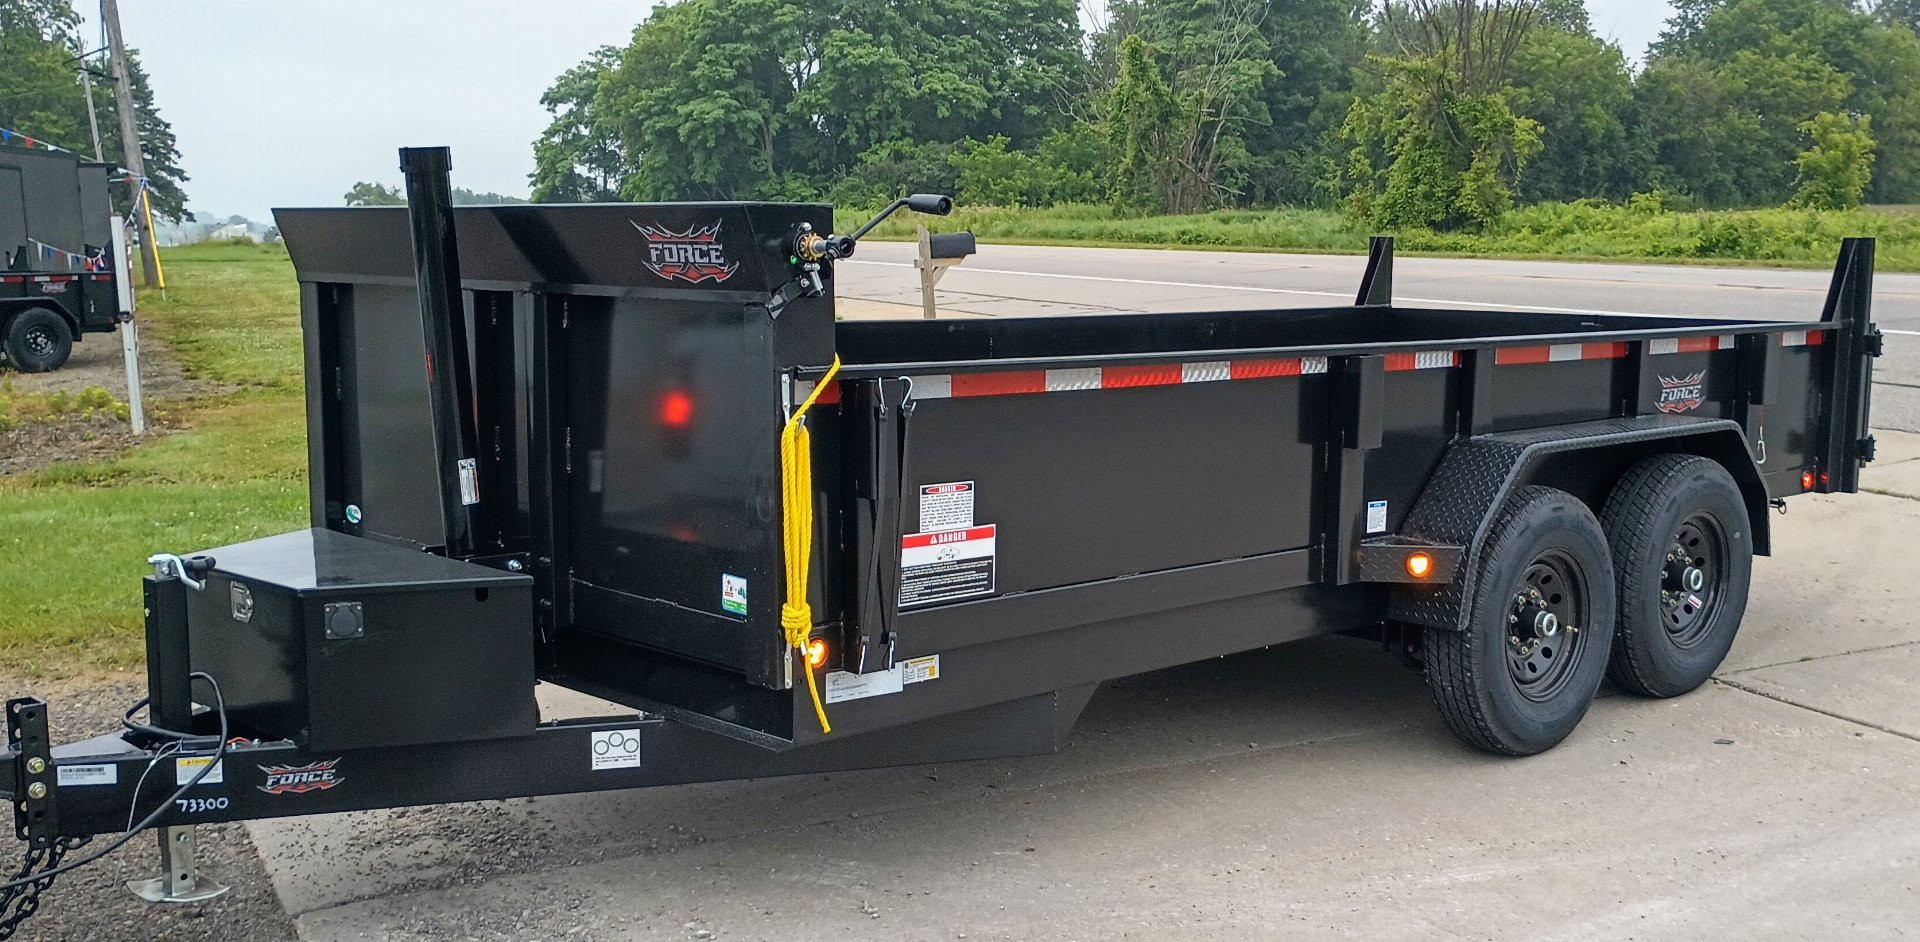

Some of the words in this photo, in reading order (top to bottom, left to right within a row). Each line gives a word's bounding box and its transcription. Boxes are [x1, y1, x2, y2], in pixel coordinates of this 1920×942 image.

[648, 243, 724, 264] FORCE
[1660, 385, 1702, 402] FORCE
[938, 531, 967, 544] DANGER
[266, 769, 336, 788] FORCE
[175, 797, 229, 813] 73300
